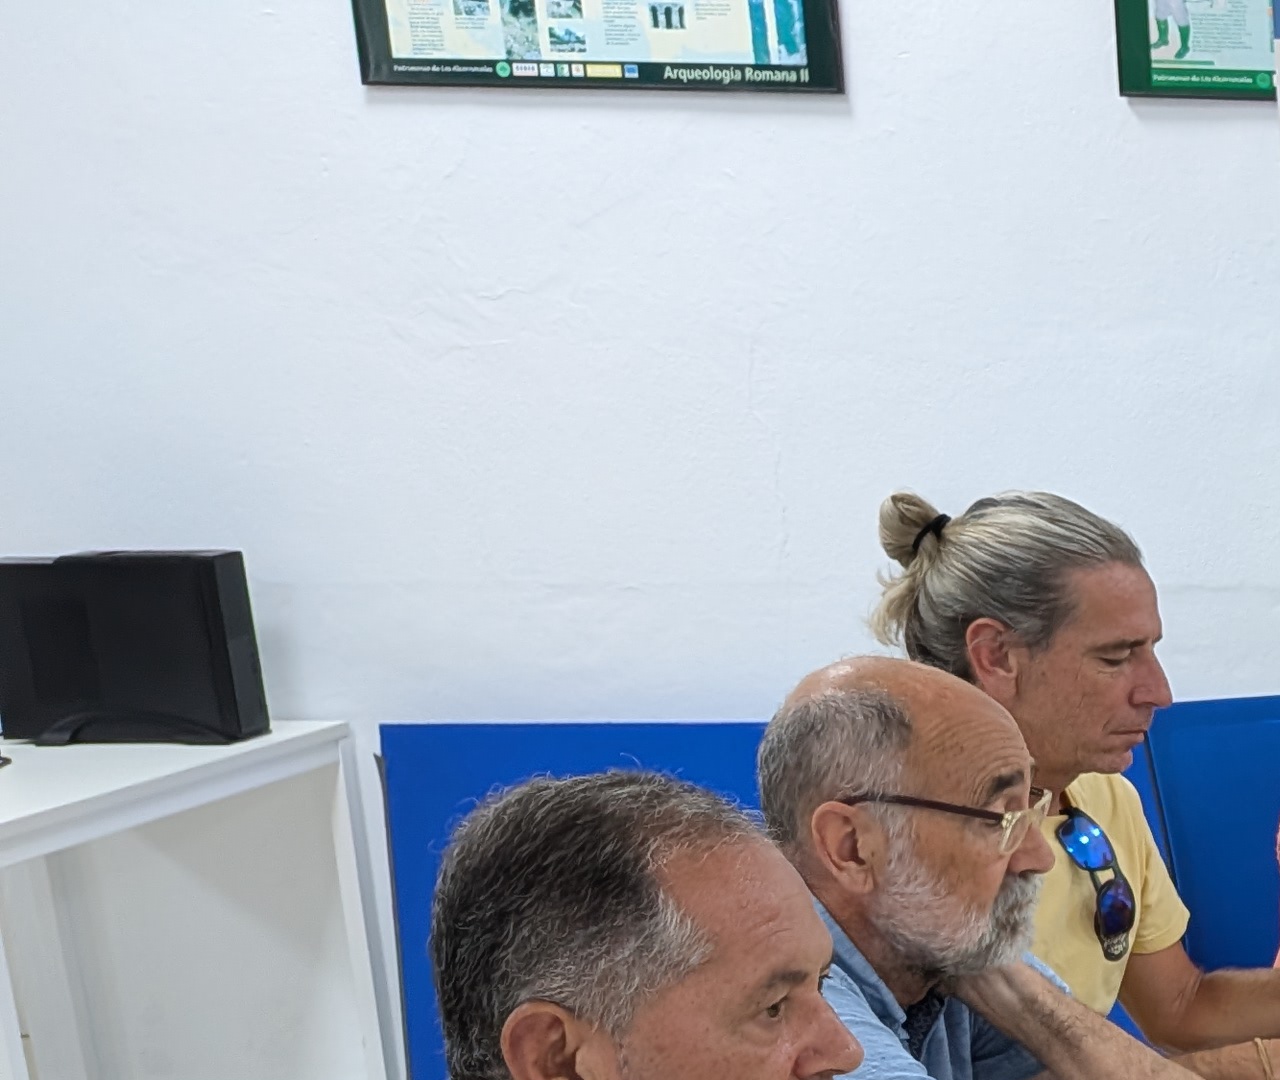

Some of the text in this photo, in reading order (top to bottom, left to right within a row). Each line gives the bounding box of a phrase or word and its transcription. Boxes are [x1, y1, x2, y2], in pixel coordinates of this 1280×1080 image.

[664, 65, 811, 84] Arqueología Romana II
